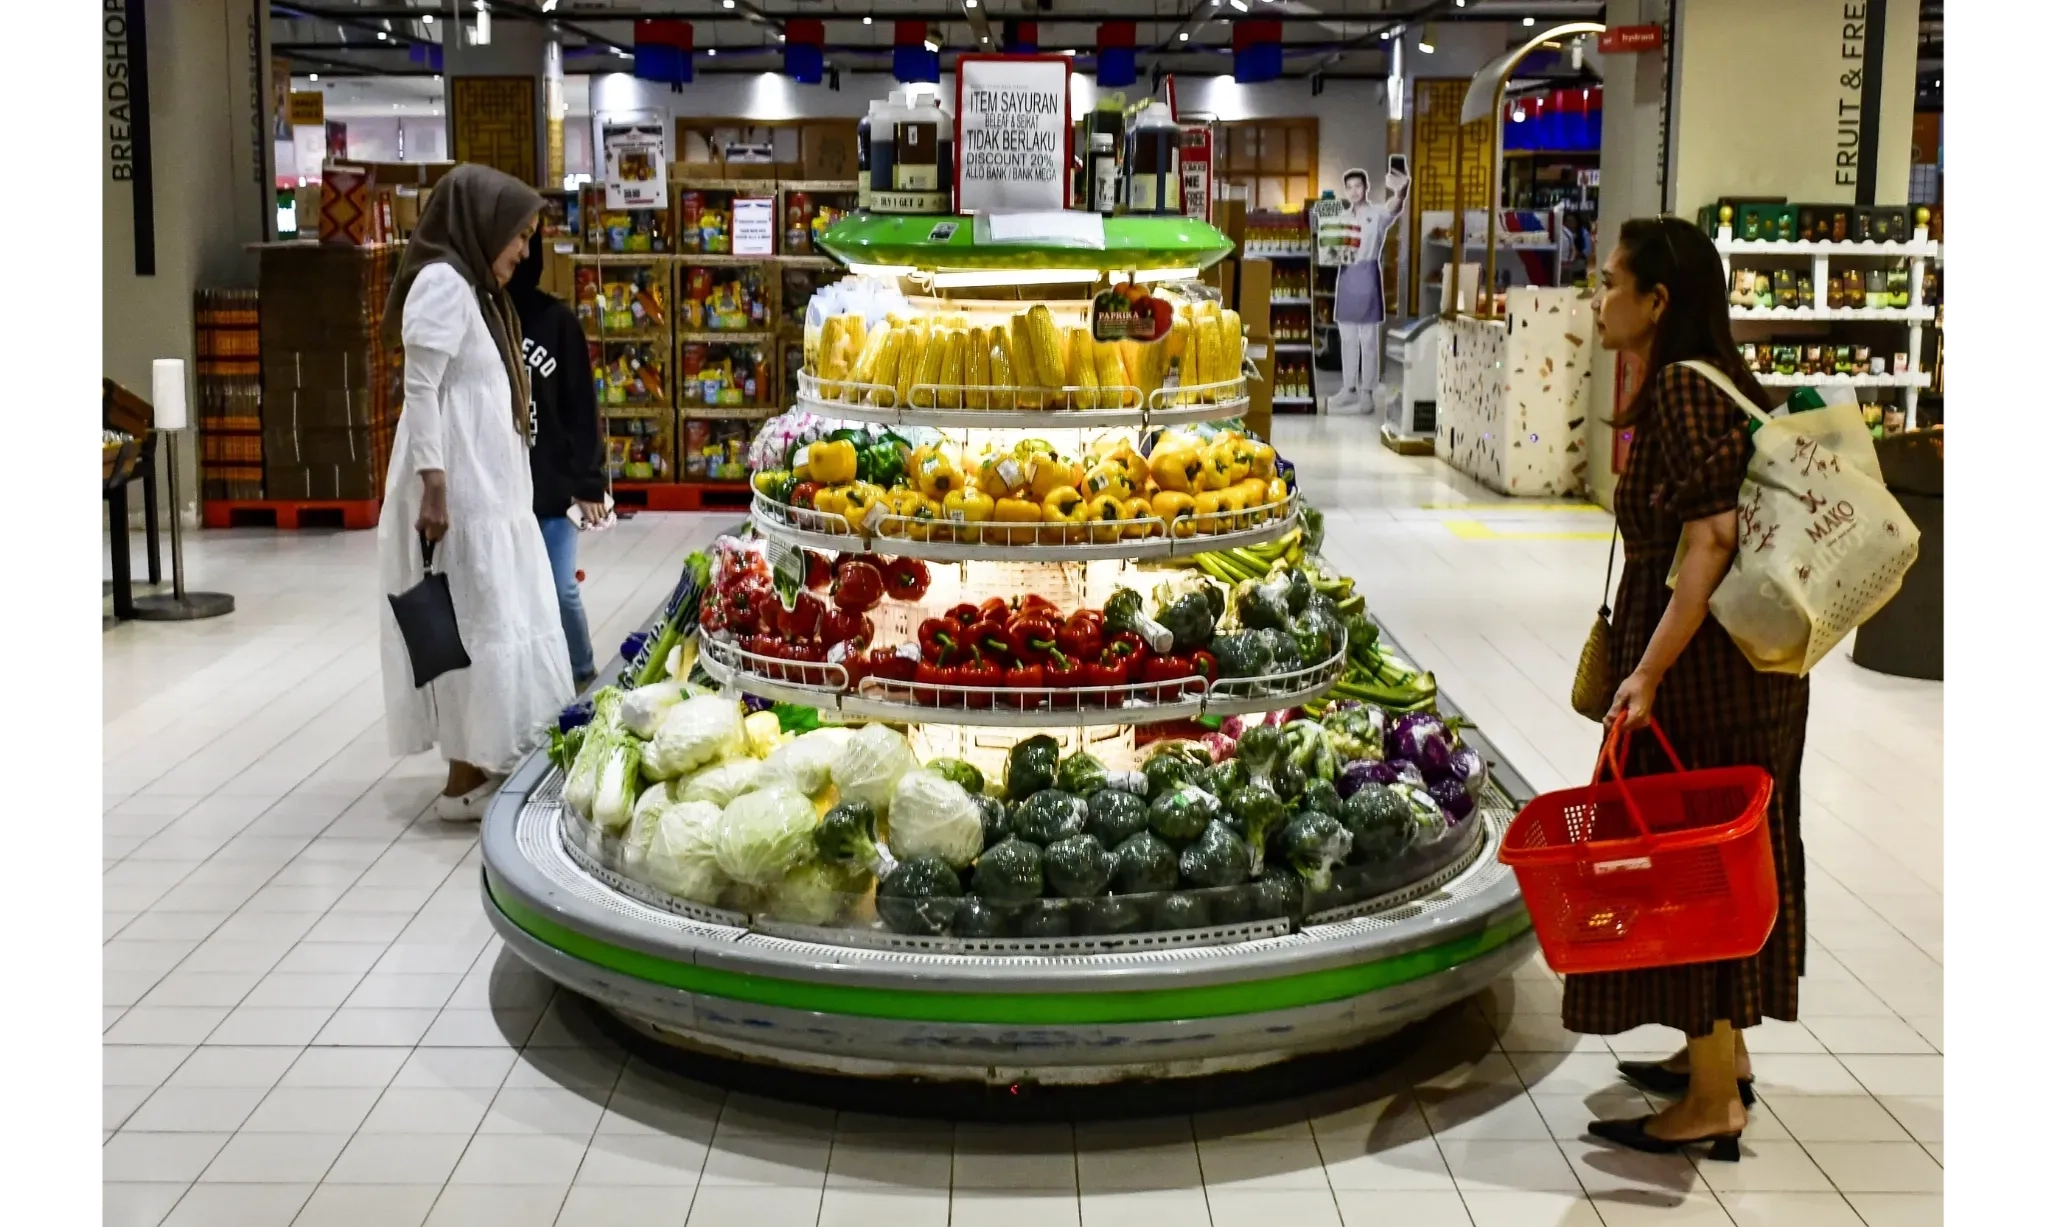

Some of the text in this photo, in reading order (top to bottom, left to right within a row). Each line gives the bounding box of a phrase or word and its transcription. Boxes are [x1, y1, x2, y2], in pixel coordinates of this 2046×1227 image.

[104, 0, 133, 182] BREADSHOP
[970, 91, 1058, 114] ITEM SAYURAN
[1835, 0, 1866, 186] FRUIT & FRE
[985, 113, 1009, 128] BELEAF
[966, 129, 1056, 152] TIDAK BERLAKU
[966, 152, 1054, 168] DISCOUNT 20%
[965, 166, 985, 180] ALLO
[986, 166, 1007, 180] BANK
[1012, 167, 1033, 181] BANK
[1034, 167, 1057, 182] MEGA
[1098, 311, 1140, 321] PAPRIKA
[521, 337, 557, 378] EGO
[1804, 500, 1855, 545] MAKO
